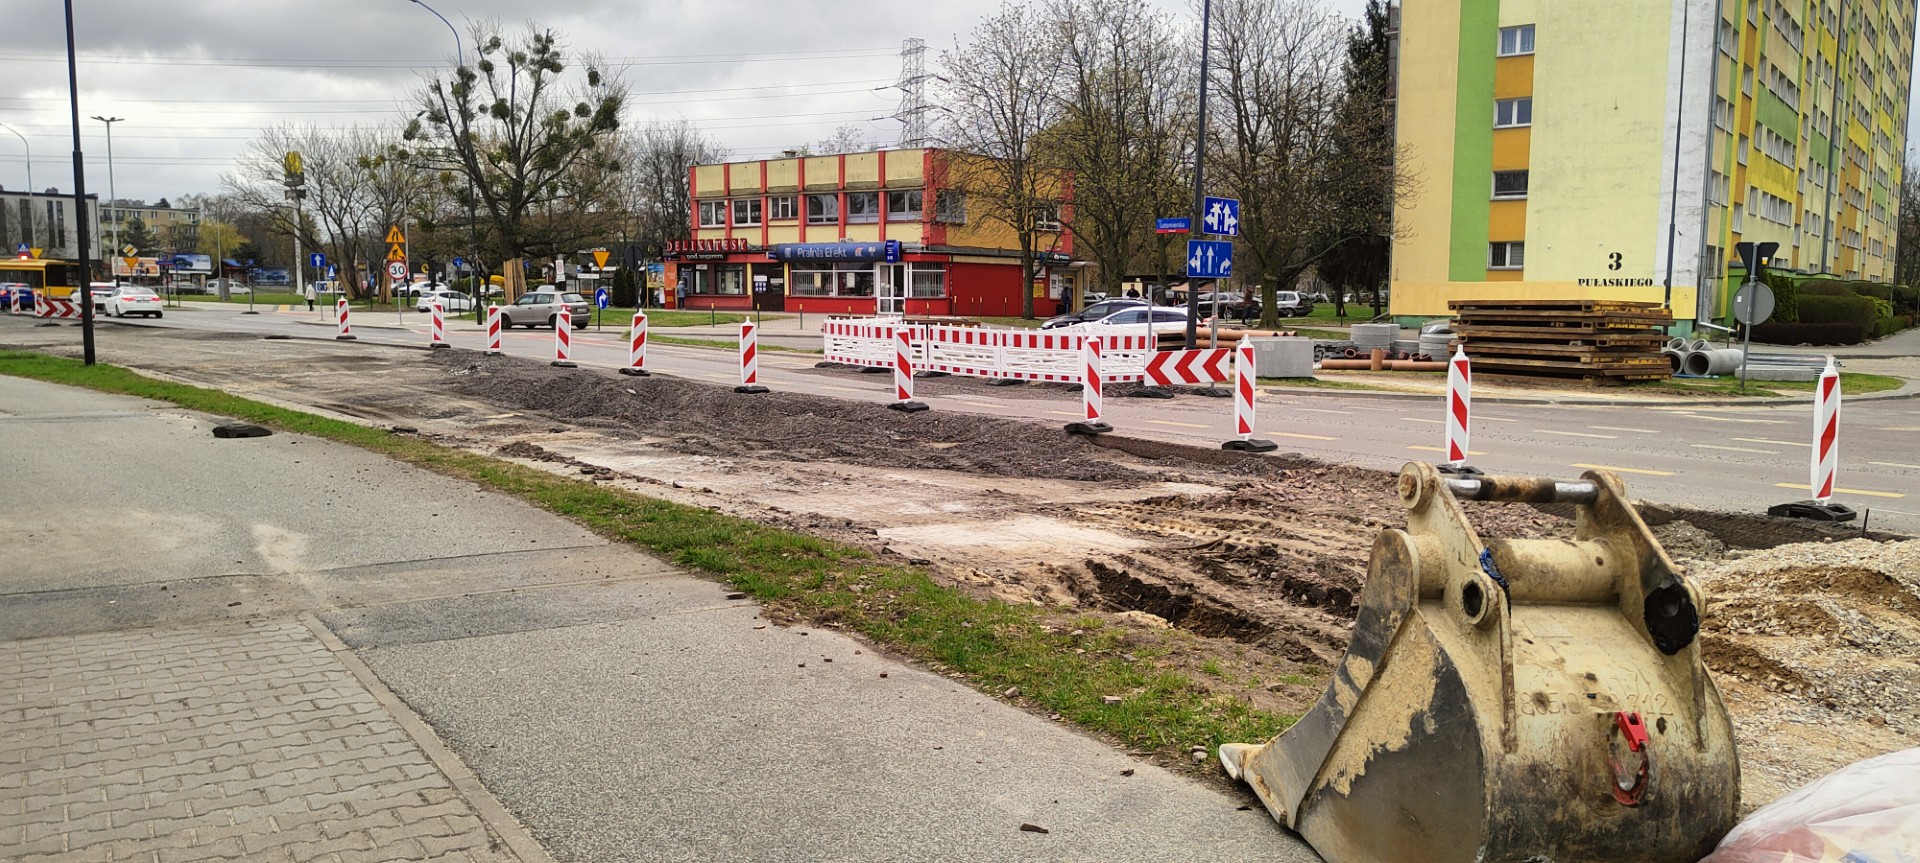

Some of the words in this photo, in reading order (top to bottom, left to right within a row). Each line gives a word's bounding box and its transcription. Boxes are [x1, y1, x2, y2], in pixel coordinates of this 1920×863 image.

[666, 239, 746, 251] DELIKATESY
[797, 247, 823, 258] Pralnia
[824, 247, 847, 258] Efekt
[1608, 252, 1622, 271] 3
[390, 265, 405, 275] 30
[1578, 278, 1653, 287] PUŁASKIEGO
